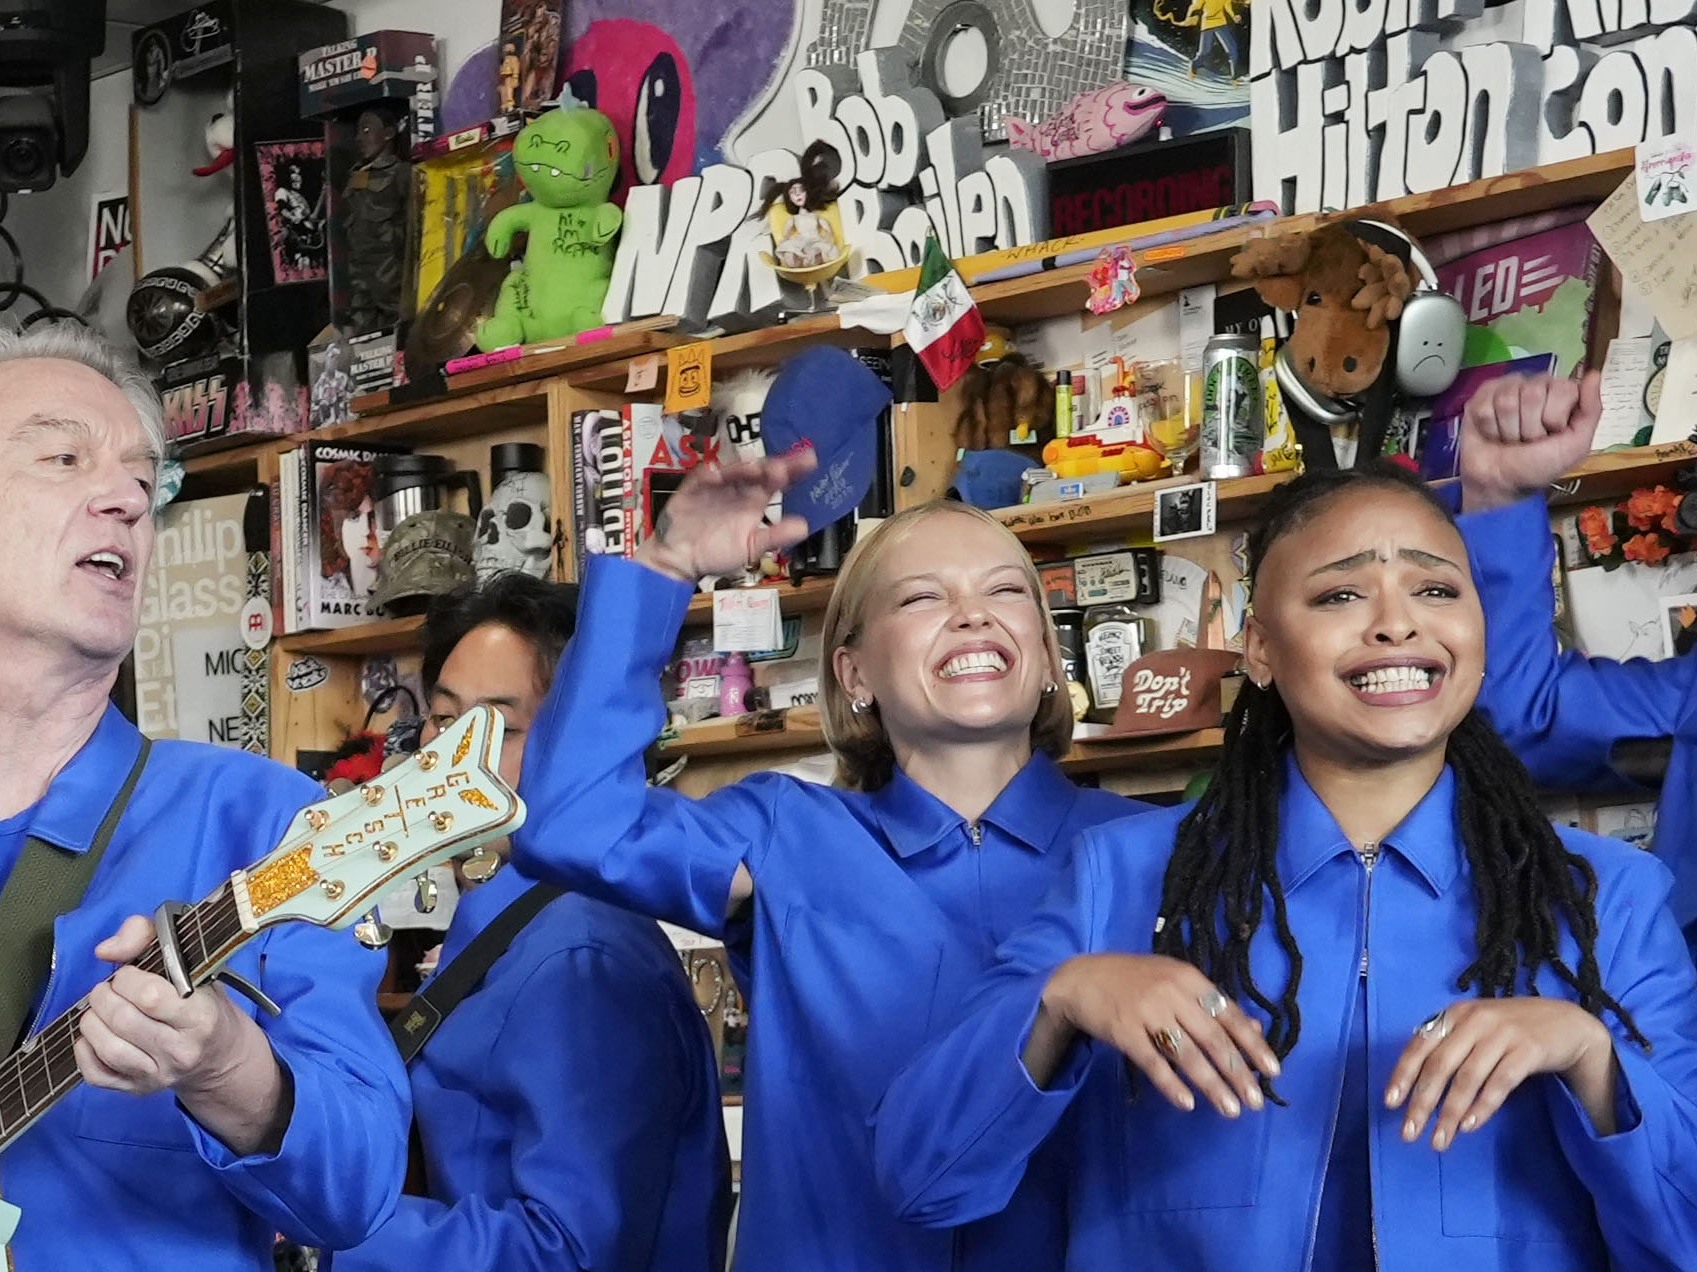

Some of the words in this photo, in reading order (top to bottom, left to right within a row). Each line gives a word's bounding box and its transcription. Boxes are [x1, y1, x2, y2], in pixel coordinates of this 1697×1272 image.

[795, 49, 918, 192] Bob
[1250, 30, 1506, 217] Hilton
[603, 149, 801, 324] NPR
[841, 121, 1032, 281] Boilen
[1133, 667, 1191, 697] Don't
[1136, 693, 1189, 718] Trip
[321, 768, 473, 862] GRETSCH
